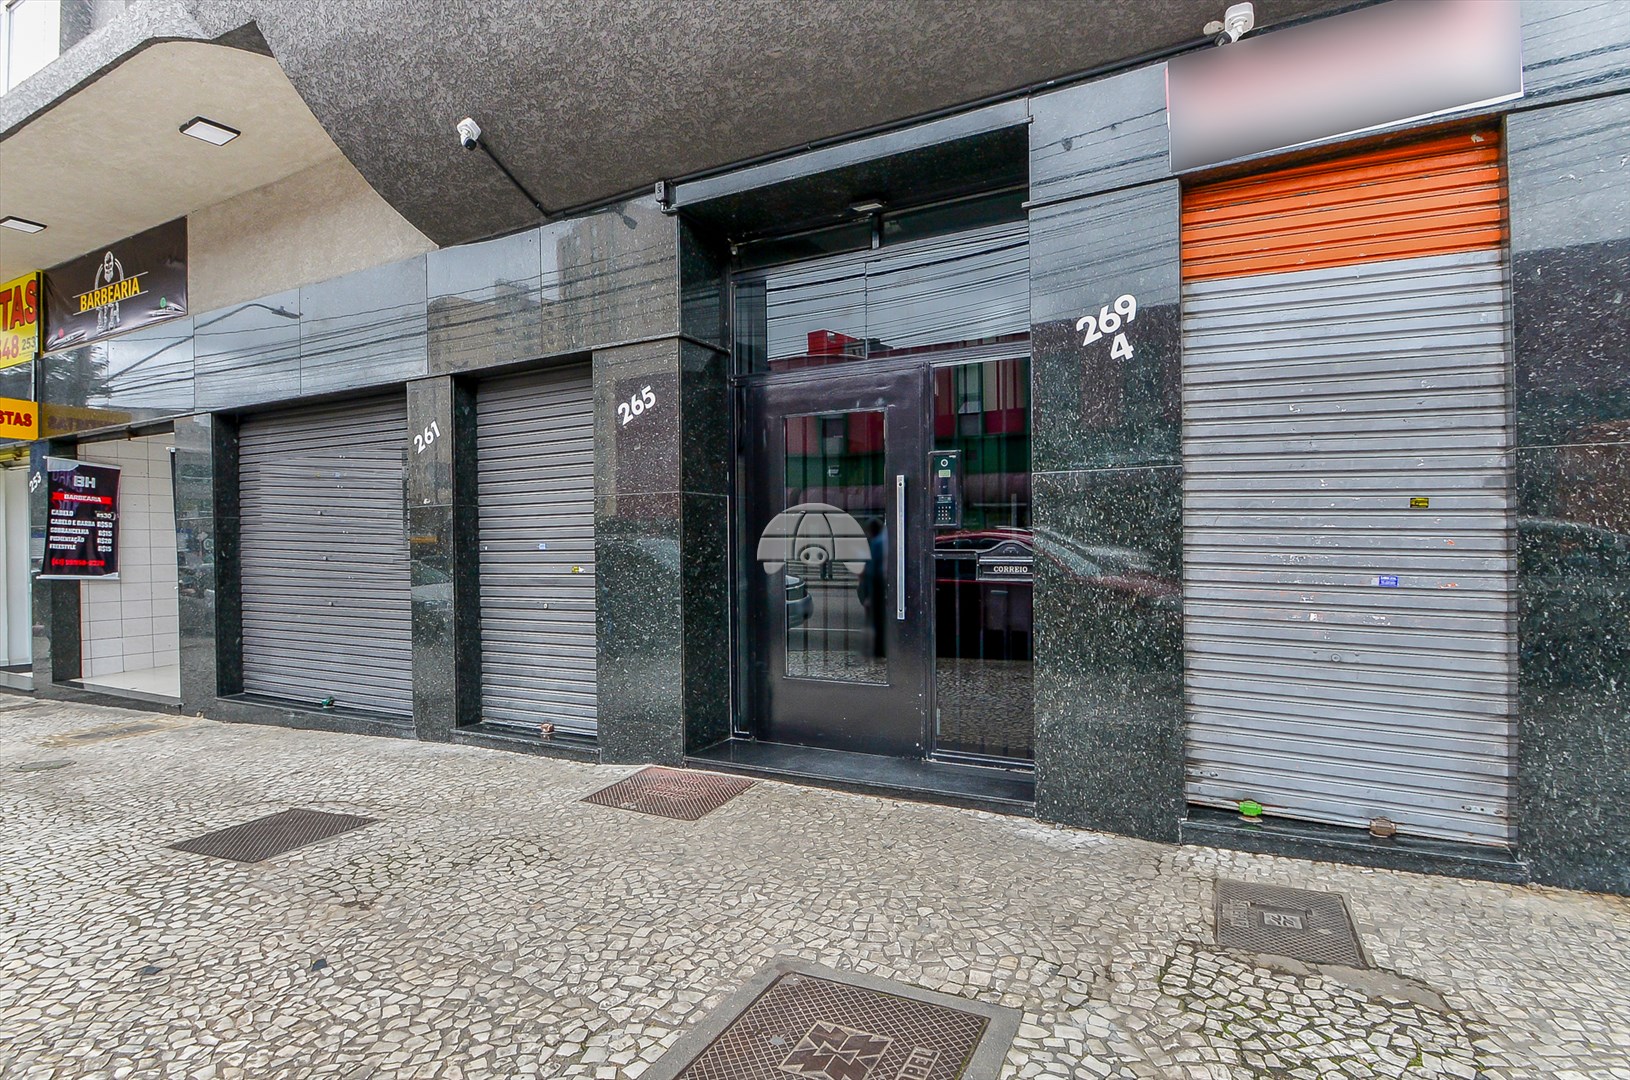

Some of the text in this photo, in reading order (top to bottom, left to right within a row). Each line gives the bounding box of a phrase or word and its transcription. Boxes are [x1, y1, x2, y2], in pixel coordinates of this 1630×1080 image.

[80, 277, 140, 312] BARBEARIA
[1076, 294, 1137, 347] 269
[1110, 332, 1134, 360] 4
[617, 385, 656, 426] 265
[413, 420, 441, 454] 261
[29, 471, 42, 493] 253
[73, 475, 96, 489] BH
[63, 493, 102, 503] BARBEARIA
[50, 518, 72, 526] CABELO
[51, 509, 74, 517] CABELO
[993, 565, 1028, 573] CORREIO
